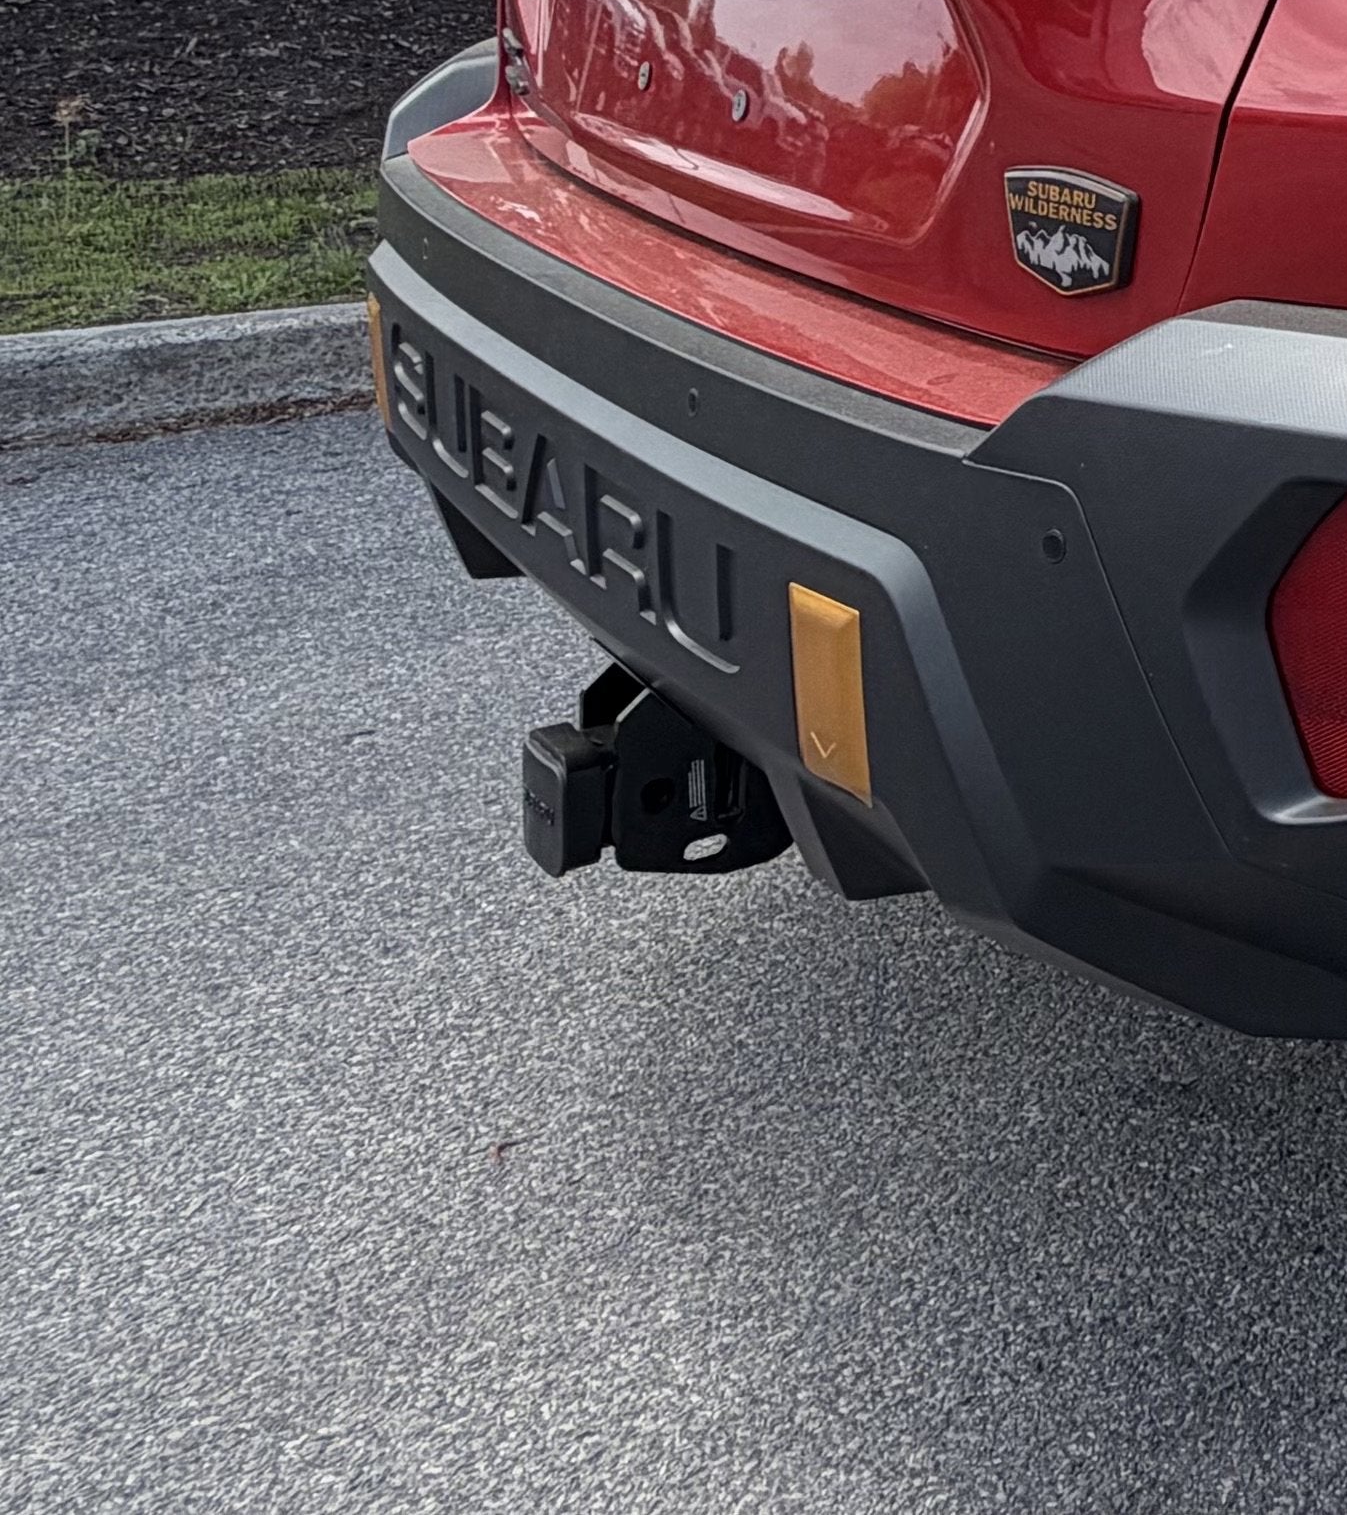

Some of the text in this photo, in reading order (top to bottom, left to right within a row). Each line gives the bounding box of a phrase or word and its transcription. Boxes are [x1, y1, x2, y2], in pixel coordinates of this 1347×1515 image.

[1008, 193, 1118, 231] WILDERNESS
[1027, 181, 1096, 209] SUBARU
[391, 322, 741, 674] SUBARU
